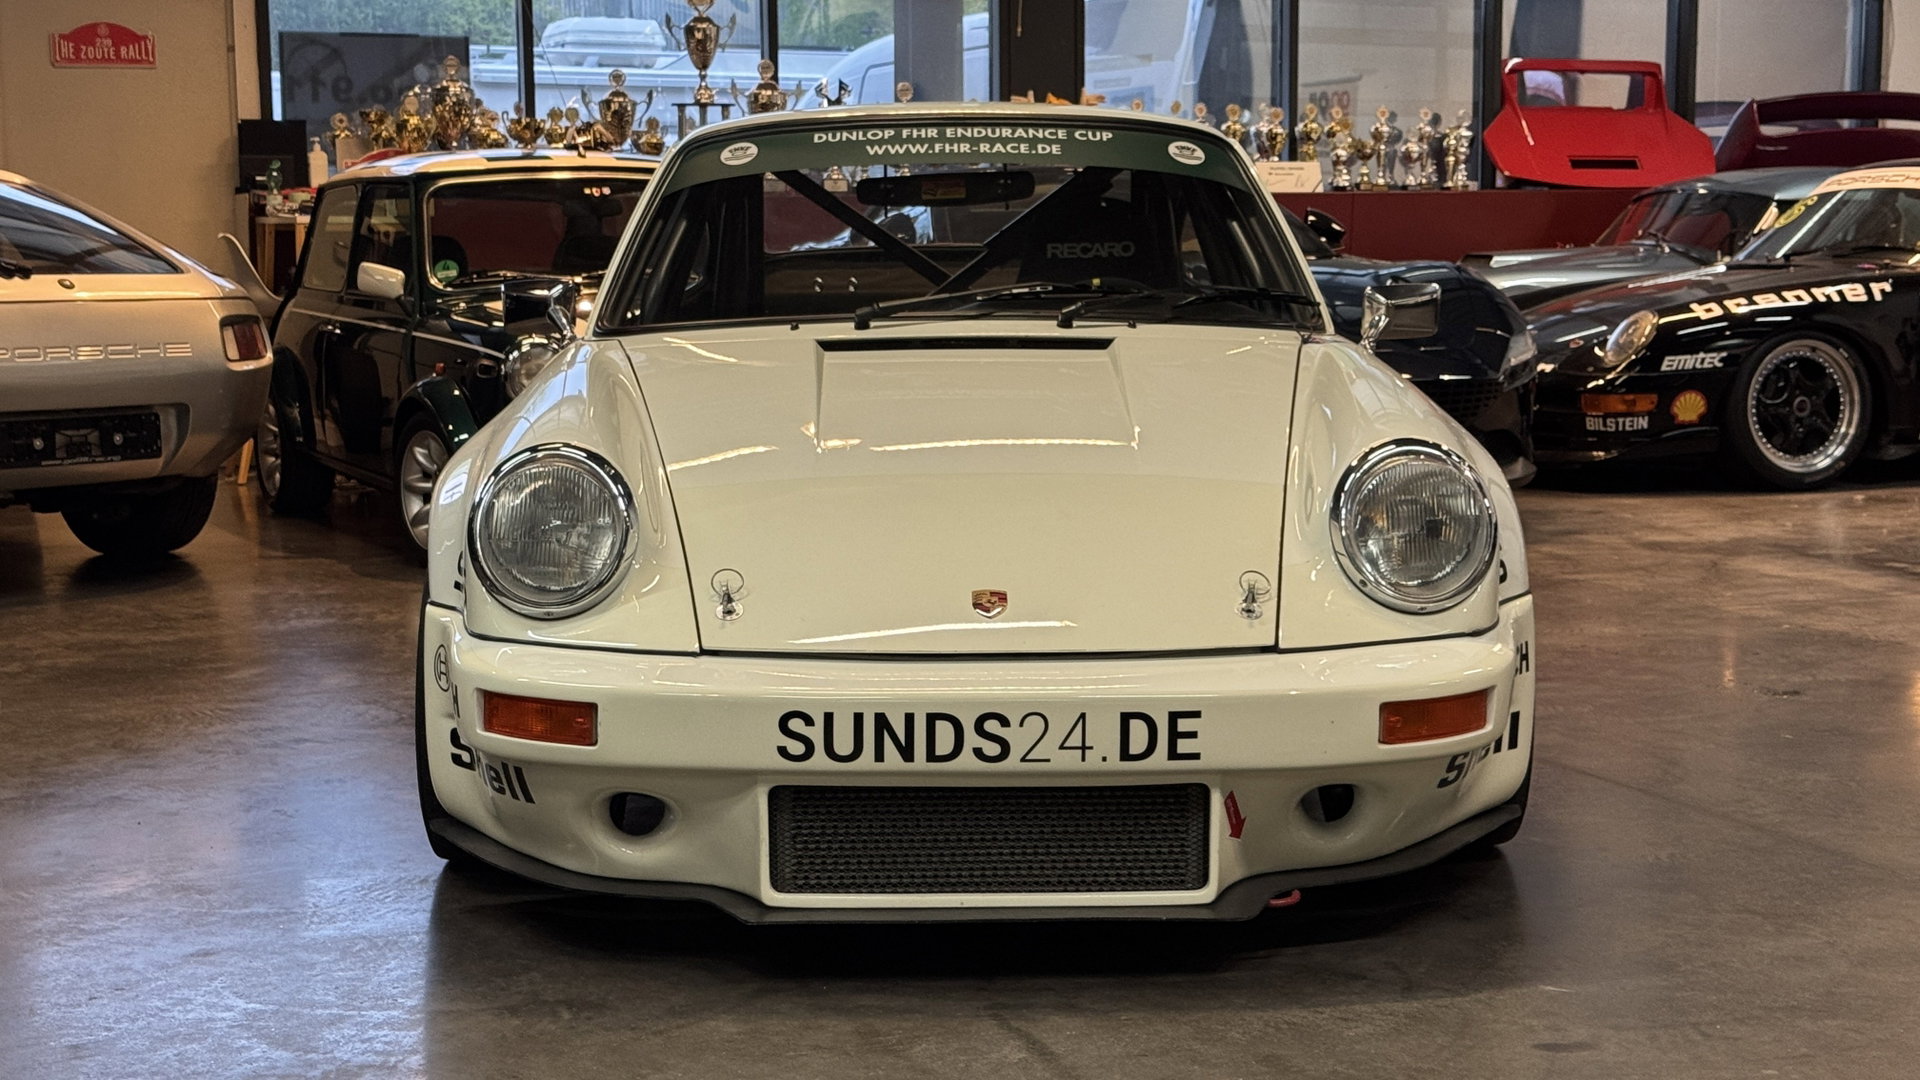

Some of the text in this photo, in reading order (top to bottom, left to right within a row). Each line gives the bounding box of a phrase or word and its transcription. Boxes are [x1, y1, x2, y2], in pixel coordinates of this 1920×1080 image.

[54, 33, 154, 62] THE ZOUTE RALLY
[813, 127, 1114, 144] DUNLOP FHR ENDURANCE CUP
[865, 142, 1063, 156] WWW.FHR-RACE.DE
[1046, 241, 1136, 259] RECARO
[1585, 416, 1650, 432] BILSTEIN
[776, 709, 1203, 764] SUNDS24.DE
